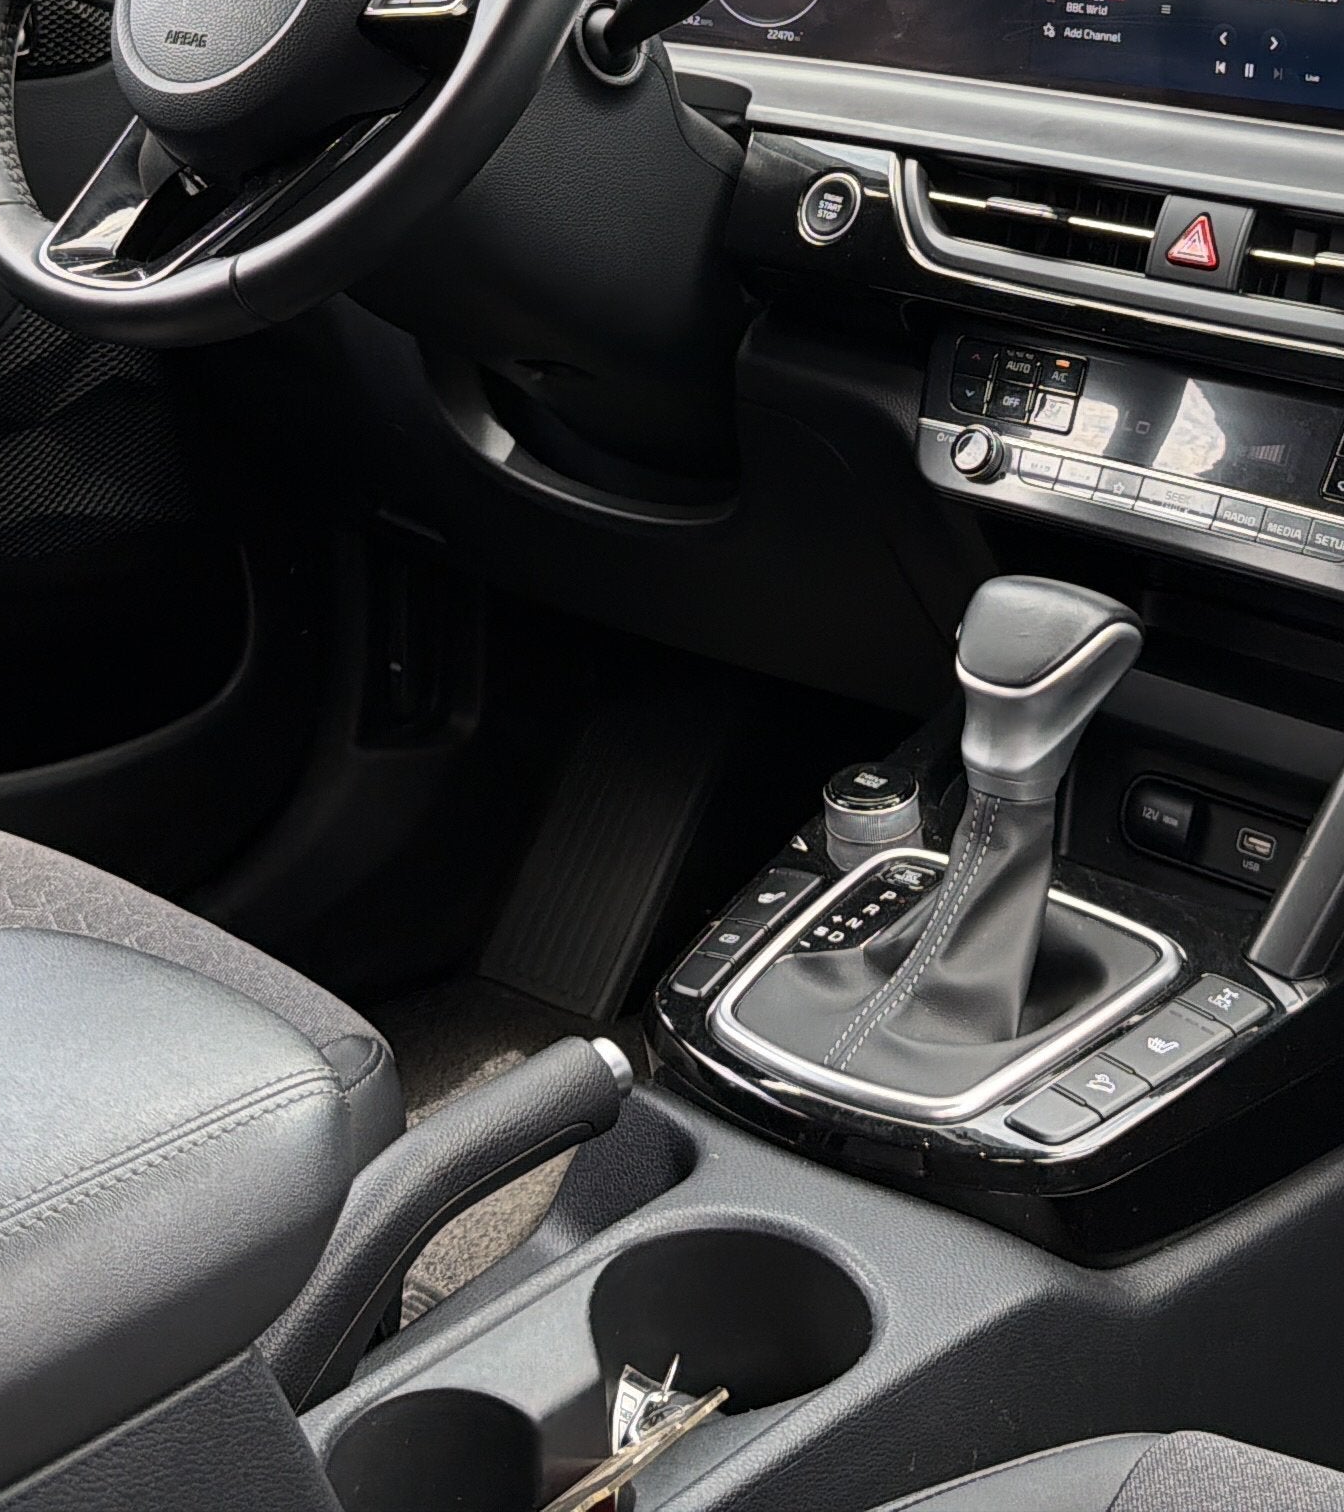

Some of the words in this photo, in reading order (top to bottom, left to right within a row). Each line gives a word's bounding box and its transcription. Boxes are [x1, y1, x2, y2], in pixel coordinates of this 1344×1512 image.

[1065, 2, 1084, 14] BBC
[767, 29, 794, 41] 22470
[1063, 26, 1083, 39] Add
[1083, 28, 1122, 43] Channel
[818, 199, 843, 213] START
[816, 208, 837, 220] STOP
[1005, 359, 1031, 375] AUTO
[1051, 370, 1068, 384] A/C
[1002, 395, 1021, 409] OFF
[1164, 490, 1193, 506] SEEK
[1223, 509, 1257, 528] RADIO
[1266, 522, 1303, 540] MEDIA
[1142, 805, 1160, 821] 12V
[1242, 859, 1260, 872] USB
[879, 889, 898, 901] P
[862, 903, 881, 917] R
[844, 916, 864, 930] N
[813, 925, 829, 937] S
[827, 930, 845, 943] D
